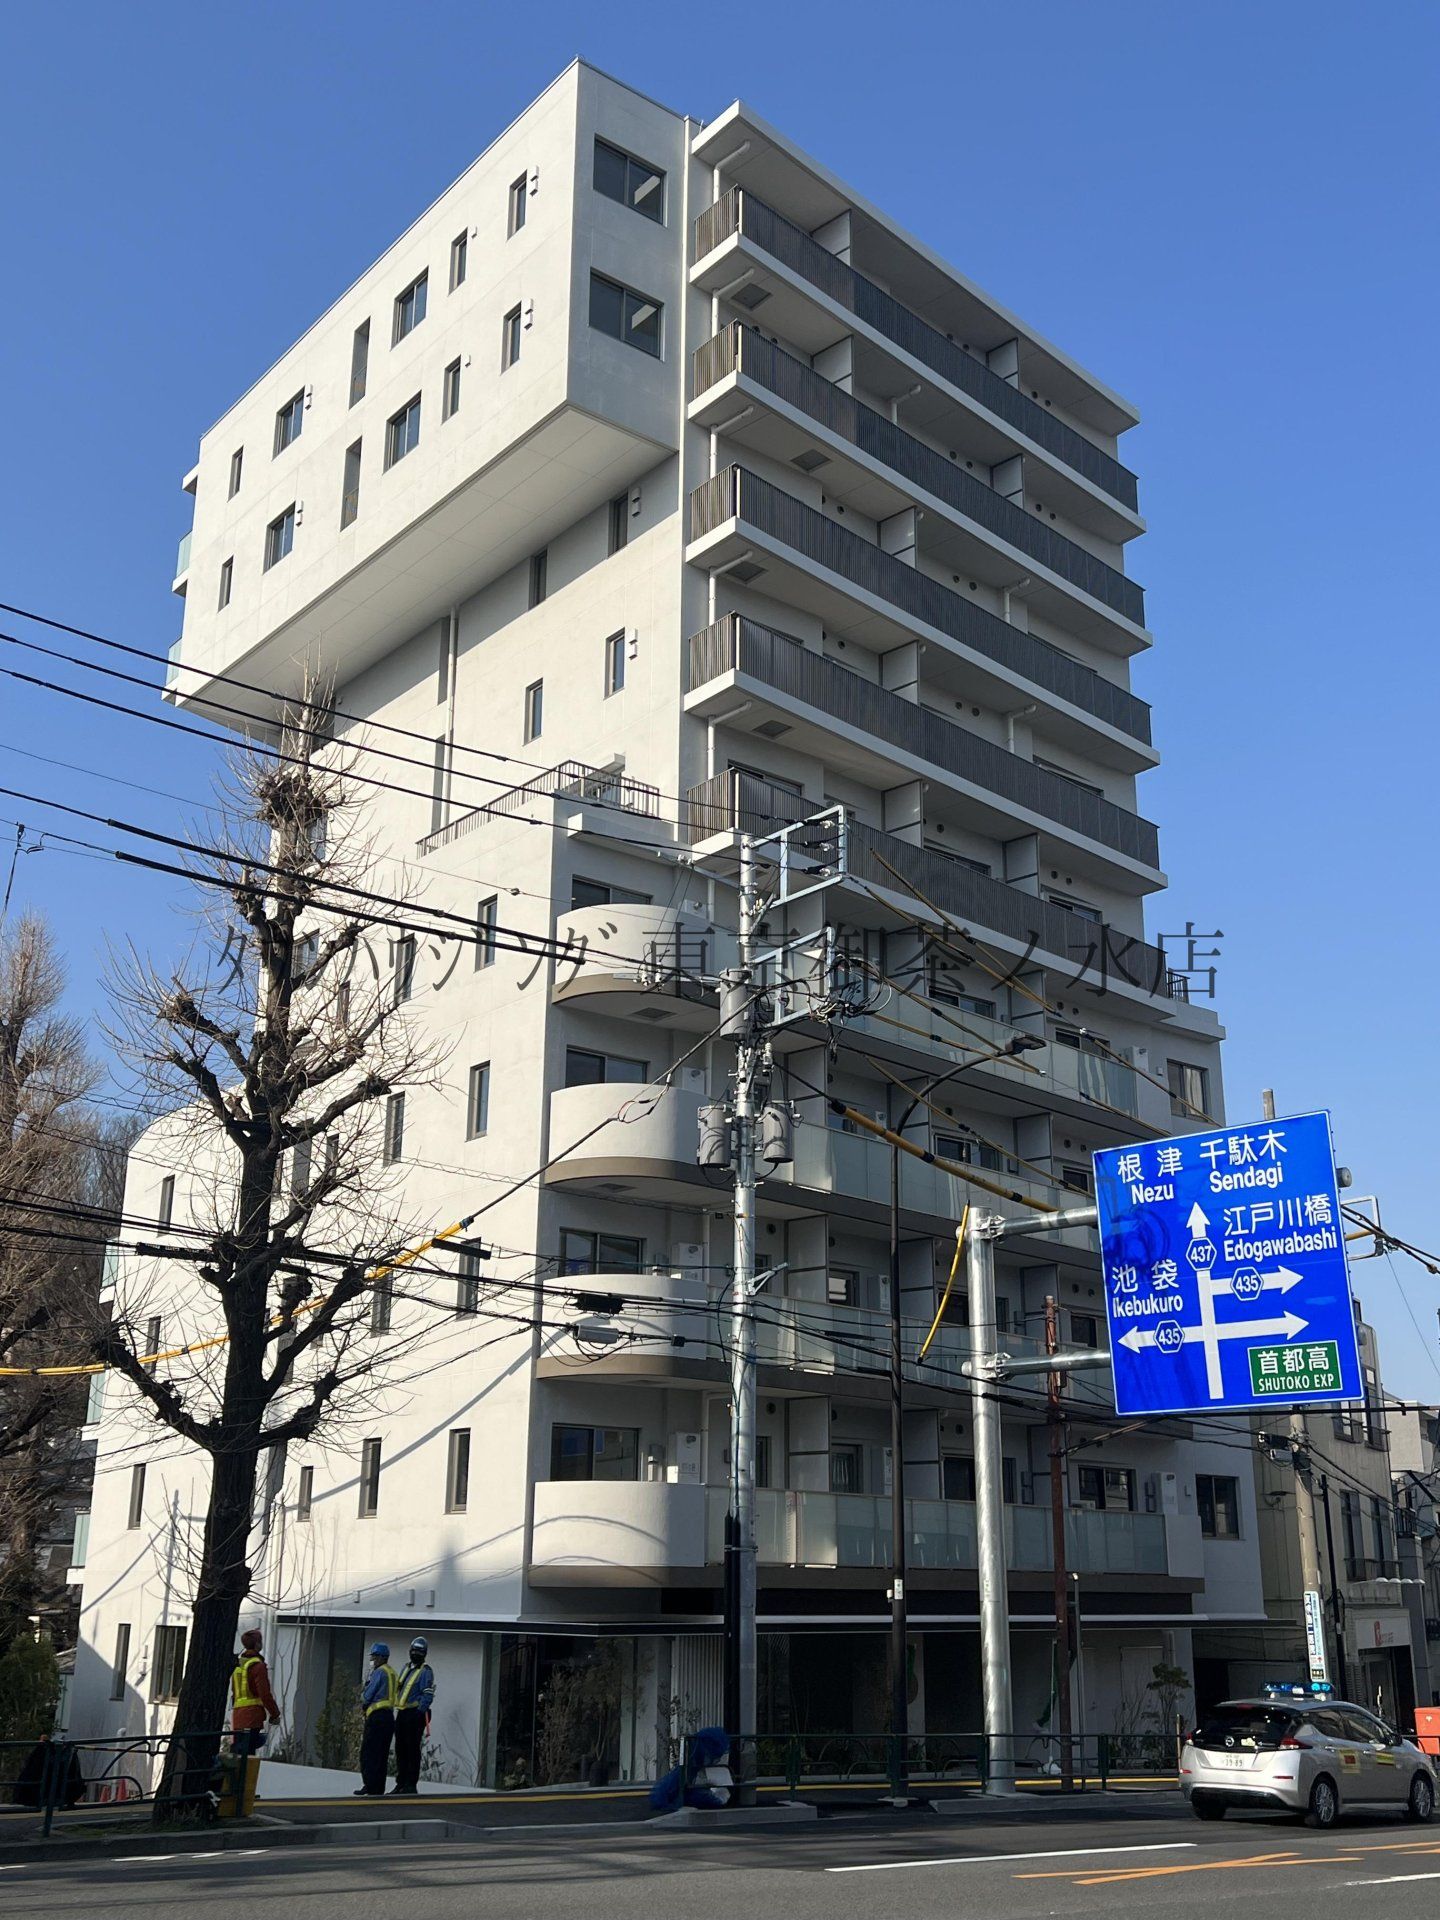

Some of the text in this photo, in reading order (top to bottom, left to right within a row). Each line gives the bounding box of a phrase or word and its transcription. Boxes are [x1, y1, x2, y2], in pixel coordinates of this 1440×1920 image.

[1200, 1129, 1288, 1169] 千駄木
[1117, 1146, 1184, 1184] 根津
[1209, 1161, 1284, 1194] Sendagi
[1131, 1182, 1175, 1205] Nezu
[1223, 1194, 1332, 1237] 江戸川橋
[1190, 1243, 1213, 1263] 437
[1224, 1226, 1338, 1264] Edogawabashi
[1112, 1258, 1180, 1295] 池袋
[1235, 1274, 1259, 1294] 435
[1112, 1293, 1184, 1319] Ikebukuro
[1157, 1327, 1181, 1346] 435
[1257, 1346, 1329, 1376] 首都高
[1258, 1374, 1335, 1393] SHUTOKO EXP
